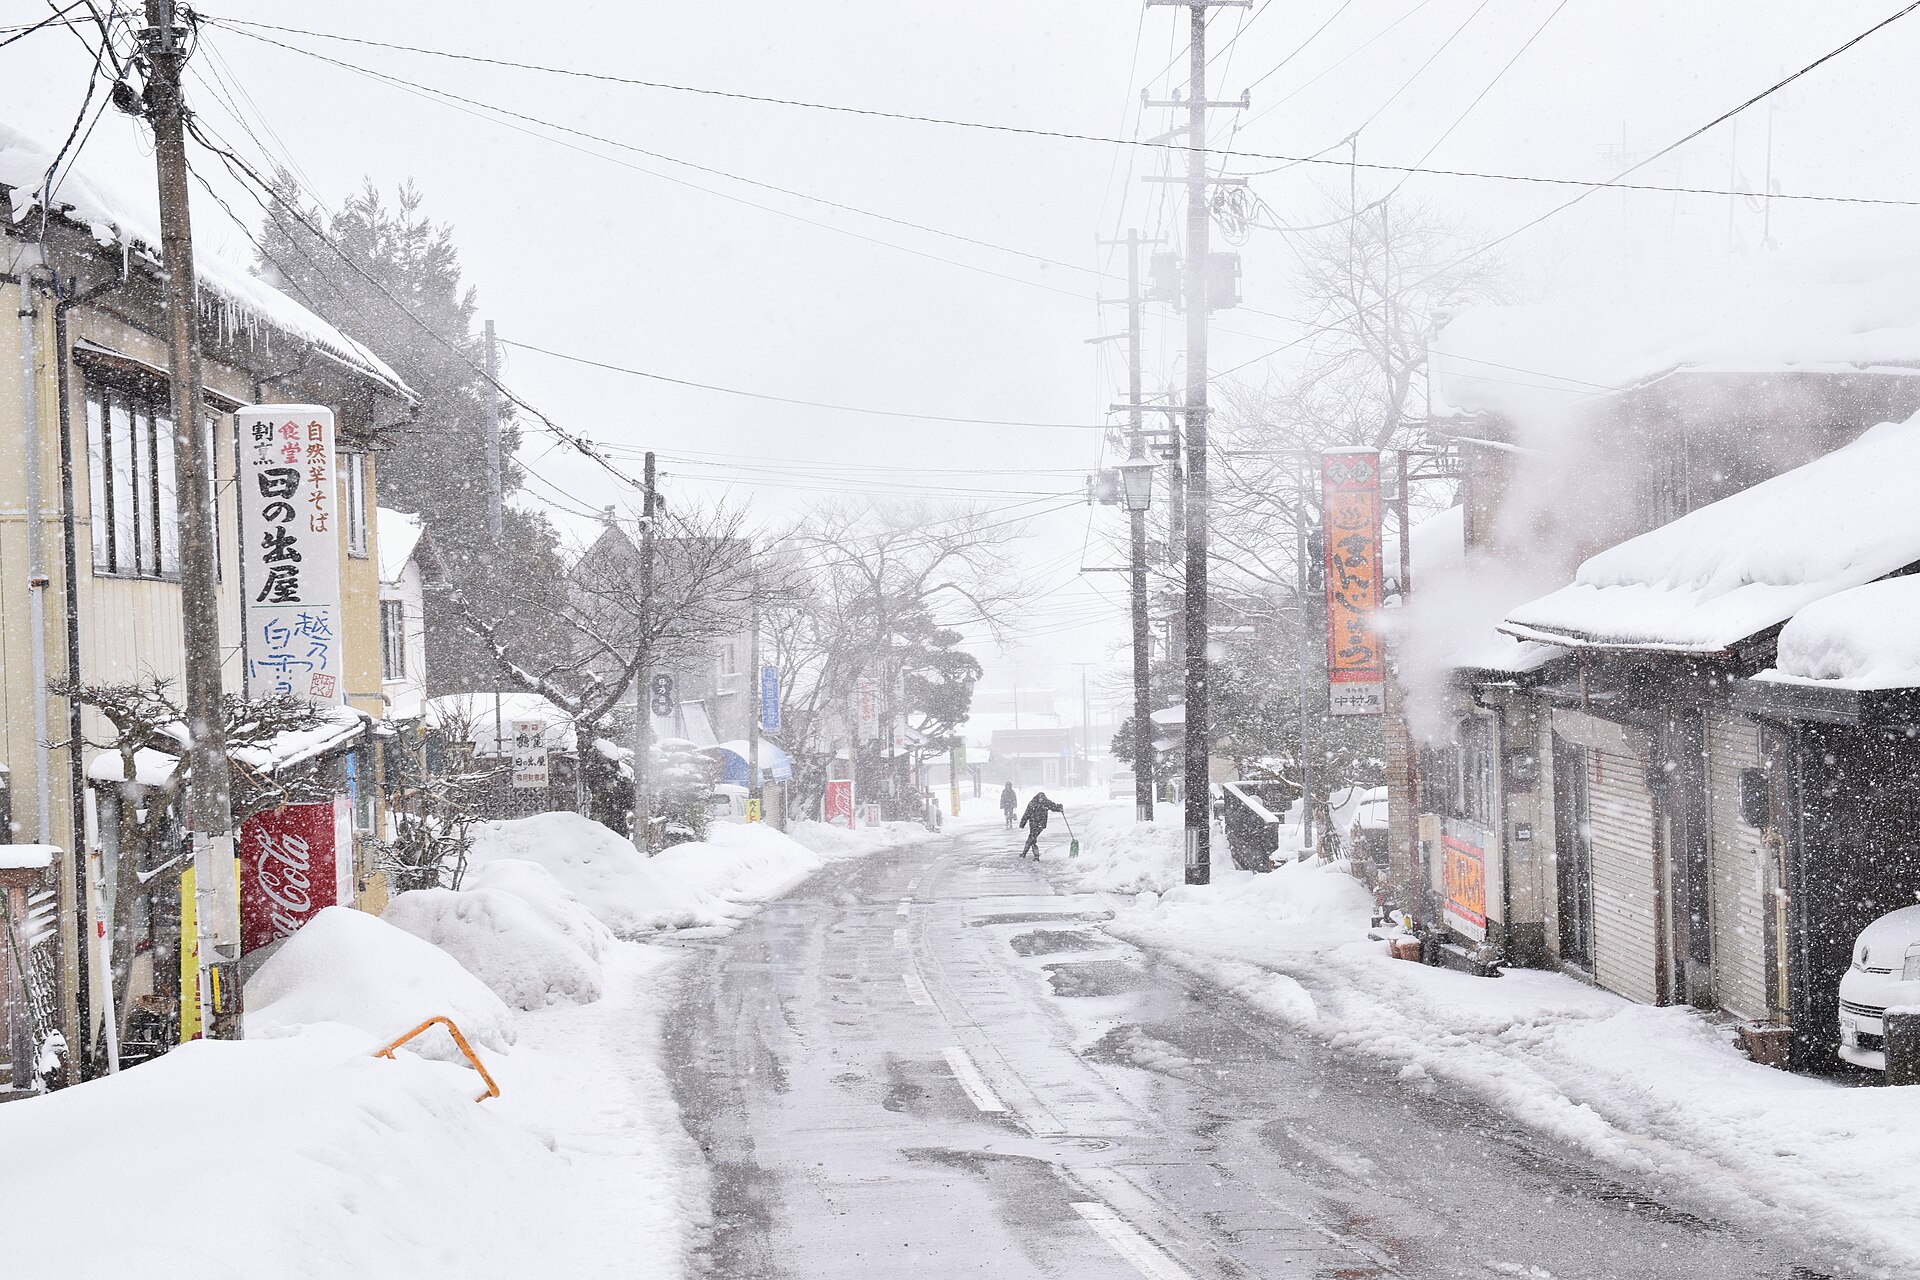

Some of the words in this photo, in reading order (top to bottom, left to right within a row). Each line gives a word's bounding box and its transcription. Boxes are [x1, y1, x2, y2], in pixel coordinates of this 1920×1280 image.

[251, 420, 275, 466] 割烹
[277, 419, 303, 465] 食堂
[255, 466, 303, 605] 日の出屋
[515, 755, 546, 767] 日の出屋
